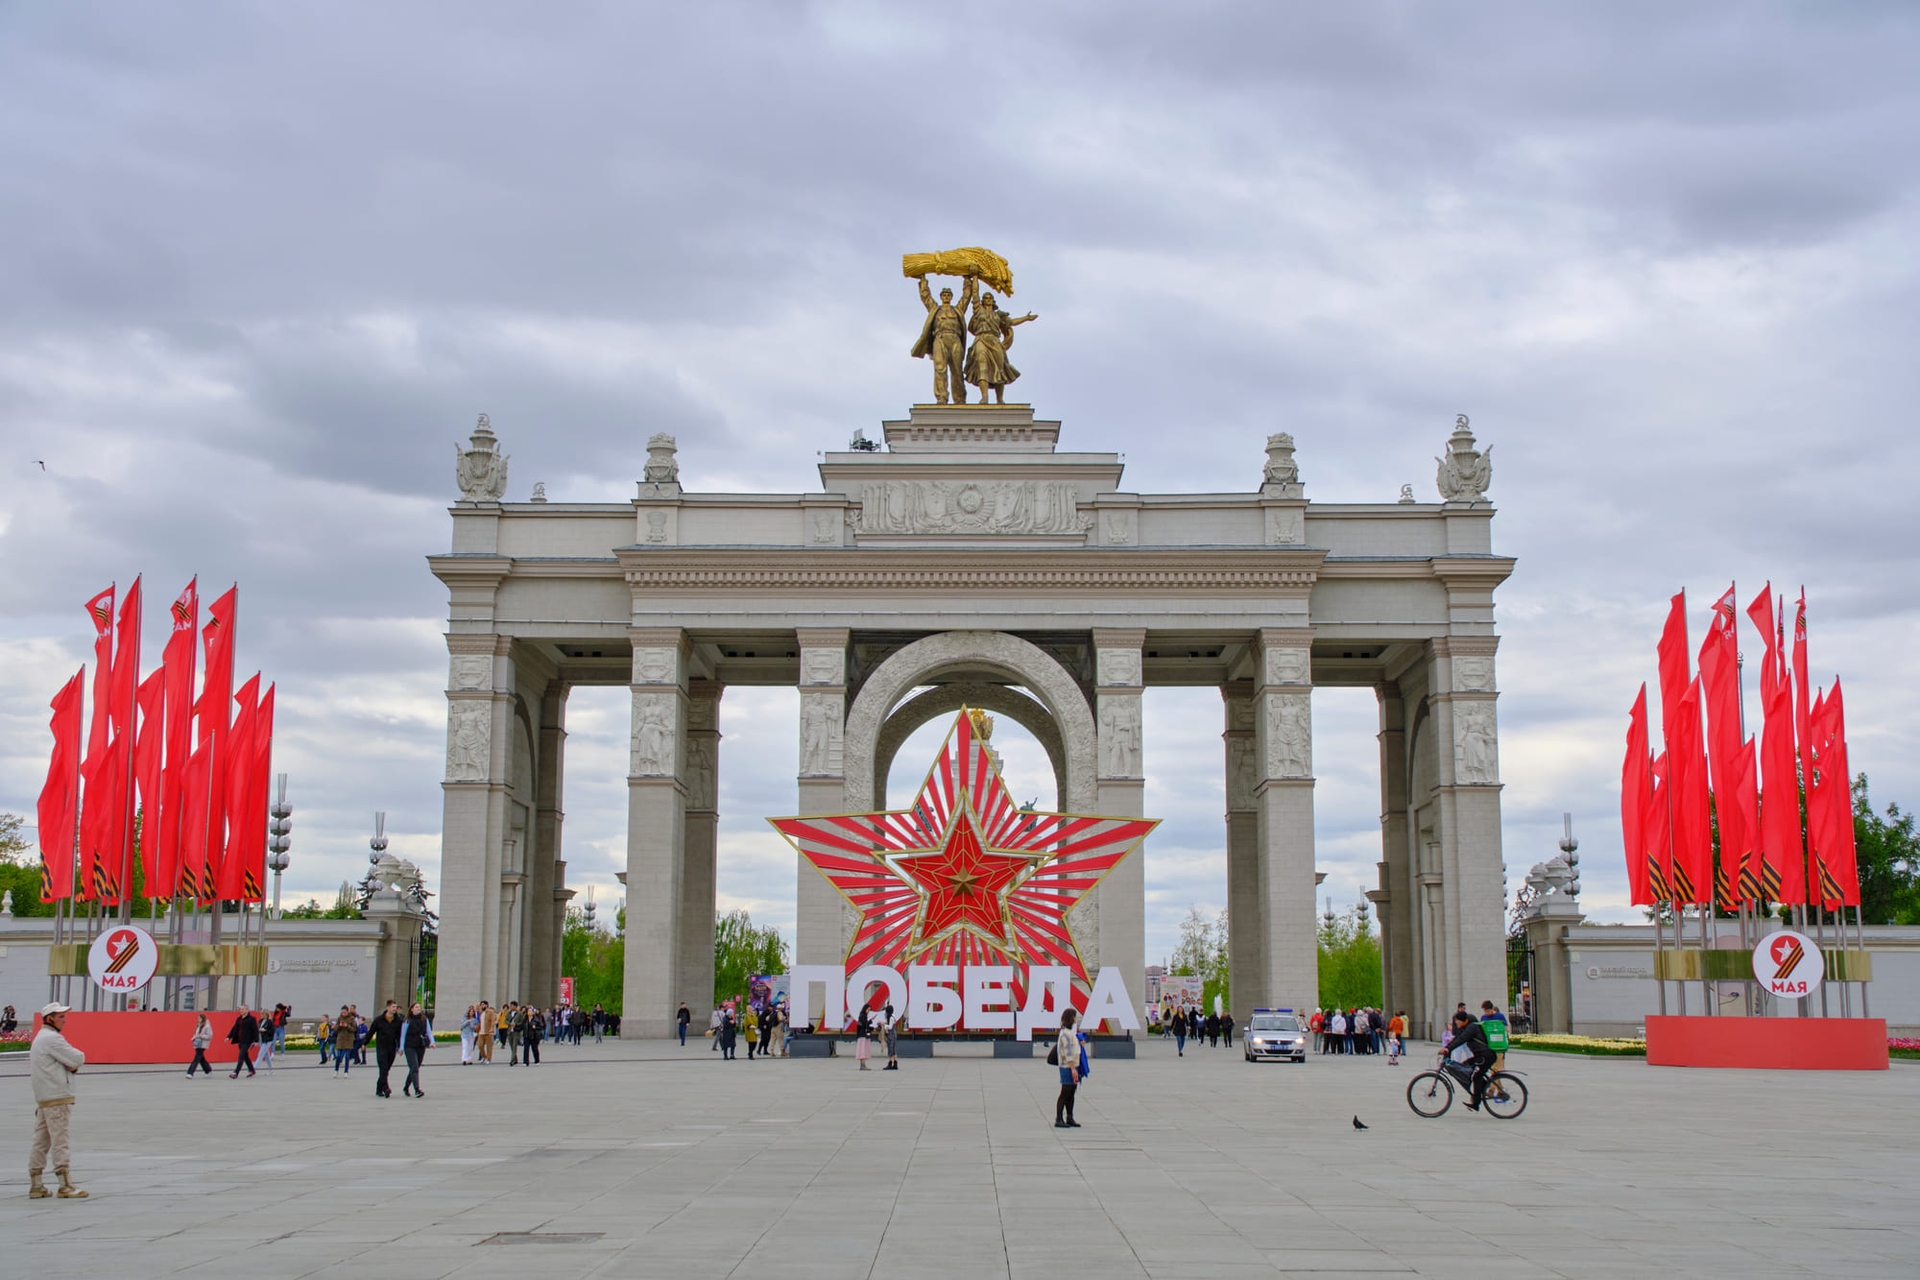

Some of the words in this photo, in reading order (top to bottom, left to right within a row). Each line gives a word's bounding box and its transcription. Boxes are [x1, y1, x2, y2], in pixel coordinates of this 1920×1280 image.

[102, 974, 137, 988] МАЯ
[1771, 980, 1808, 993] МАЯ
[789, 964, 1141, 1041] ПОБЕДА
